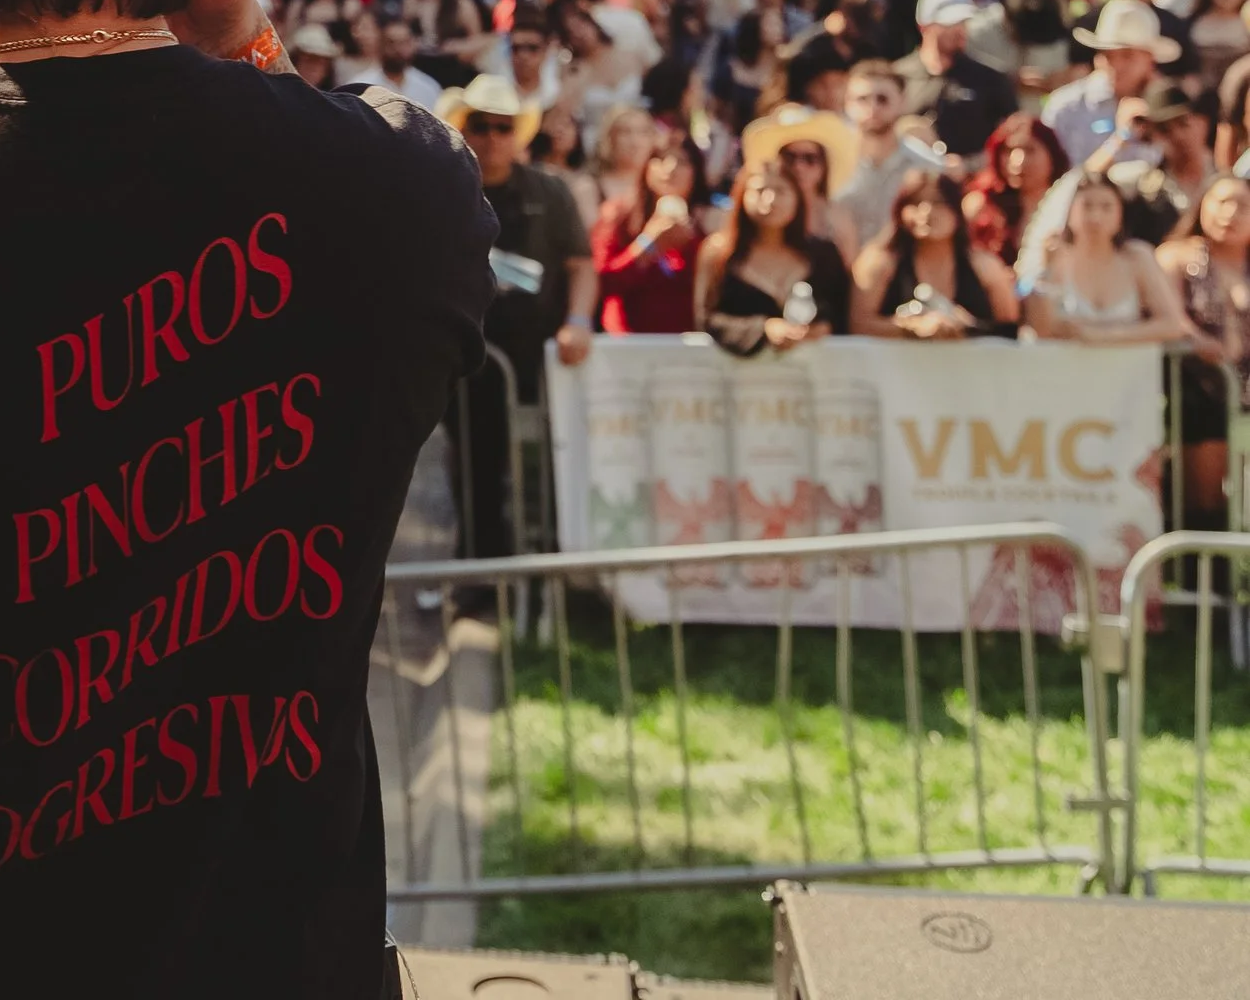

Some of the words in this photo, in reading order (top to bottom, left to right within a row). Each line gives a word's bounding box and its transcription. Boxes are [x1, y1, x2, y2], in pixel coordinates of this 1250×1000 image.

[34, 211, 294, 445] PUROS
[12, 371, 323, 605] PINCHES
[897, 417, 1117, 483] VMC
